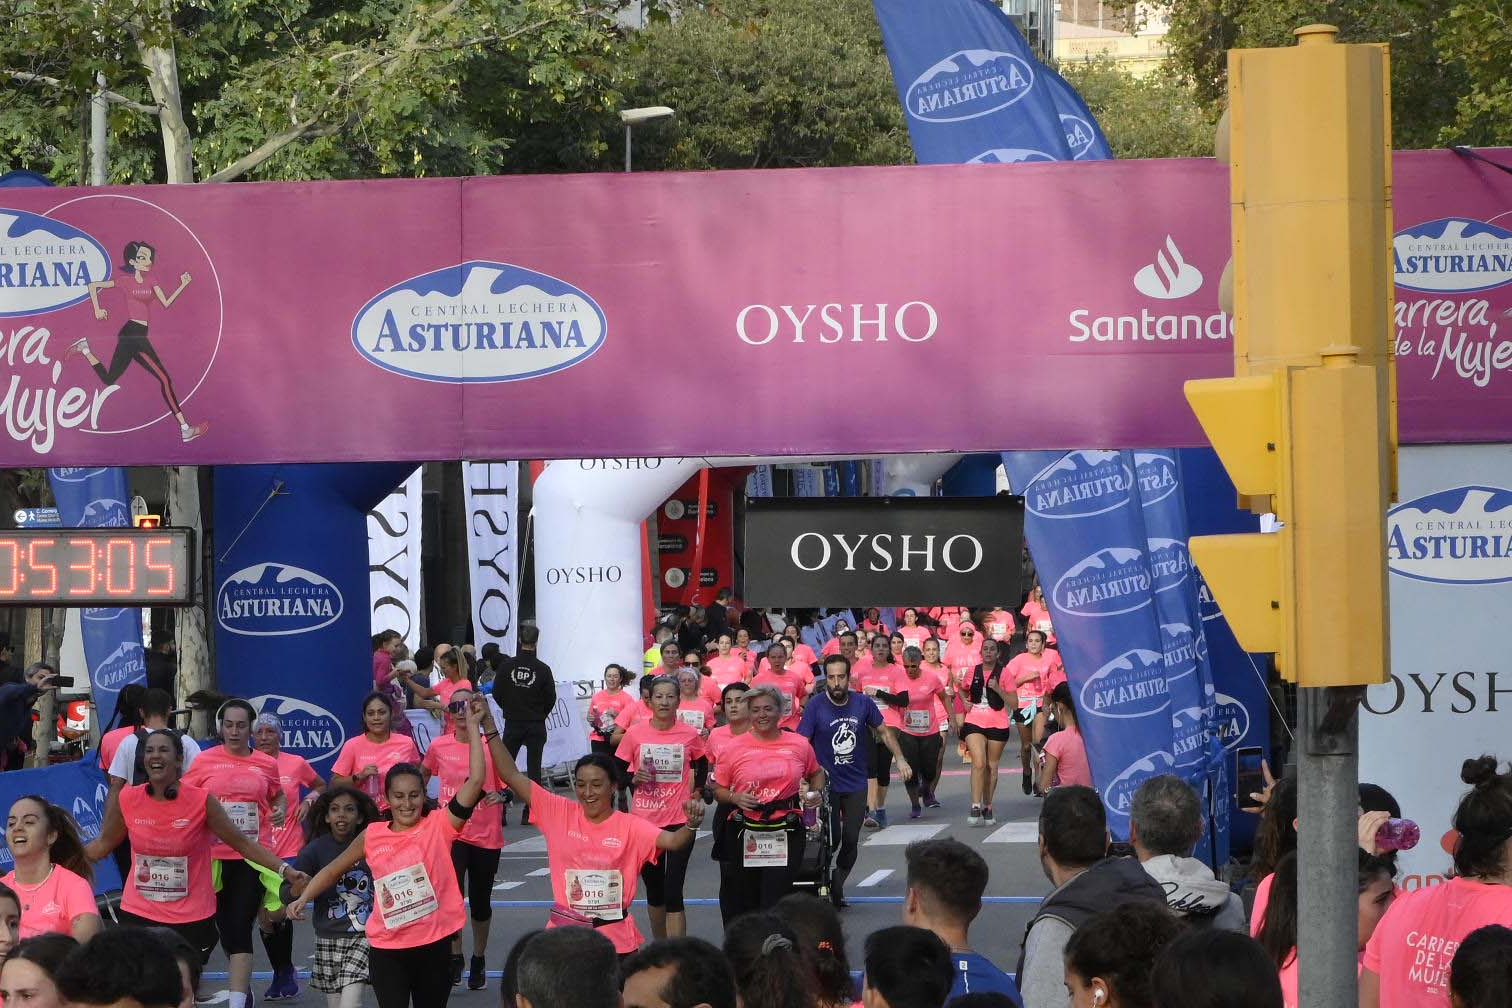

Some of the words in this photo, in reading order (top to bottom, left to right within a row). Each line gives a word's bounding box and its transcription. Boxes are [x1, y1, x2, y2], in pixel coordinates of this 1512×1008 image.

[14, 244, 86, 256] LECHERA
[1409, 243, 1458, 252] CENTRAL
[411, 303, 489, 317] CENTRAL
[498, 301, 579, 314] LECHERA
[1394, 298, 1489, 327] arrera
[371, 309, 588, 353] ASTURIANA
[736, 301, 939, 345] OYSHO
[1418, 328, 1436, 356] la
[1431, 322, 1512, 387] Muje
[1416, 521, 1482, 530] CENTRAL
[469, 461, 511, 638] OYSH
[790, 532, 983, 573] OYSHO
[367, 482, 411, 643] OYS
[546, 565, 622, 585] OYSHO
[233, 587, 276, 596] CENTRAL
[281, 586, 329, 596] LECHERA
[221, 591, 335, 620] ASTURIANA
[516, 671, 530, 680] BP
[281, 718, 331, 727] LECHERA
[635, 797, 667, 809] SUMA
[151, 873, 170, 882] 016
[394, 888, 414, 901] 016
[584, 890, 604, 898] 016
[1414, 949, 1434, 968] DE
[1408, 965, 1448, 989] MUJE
